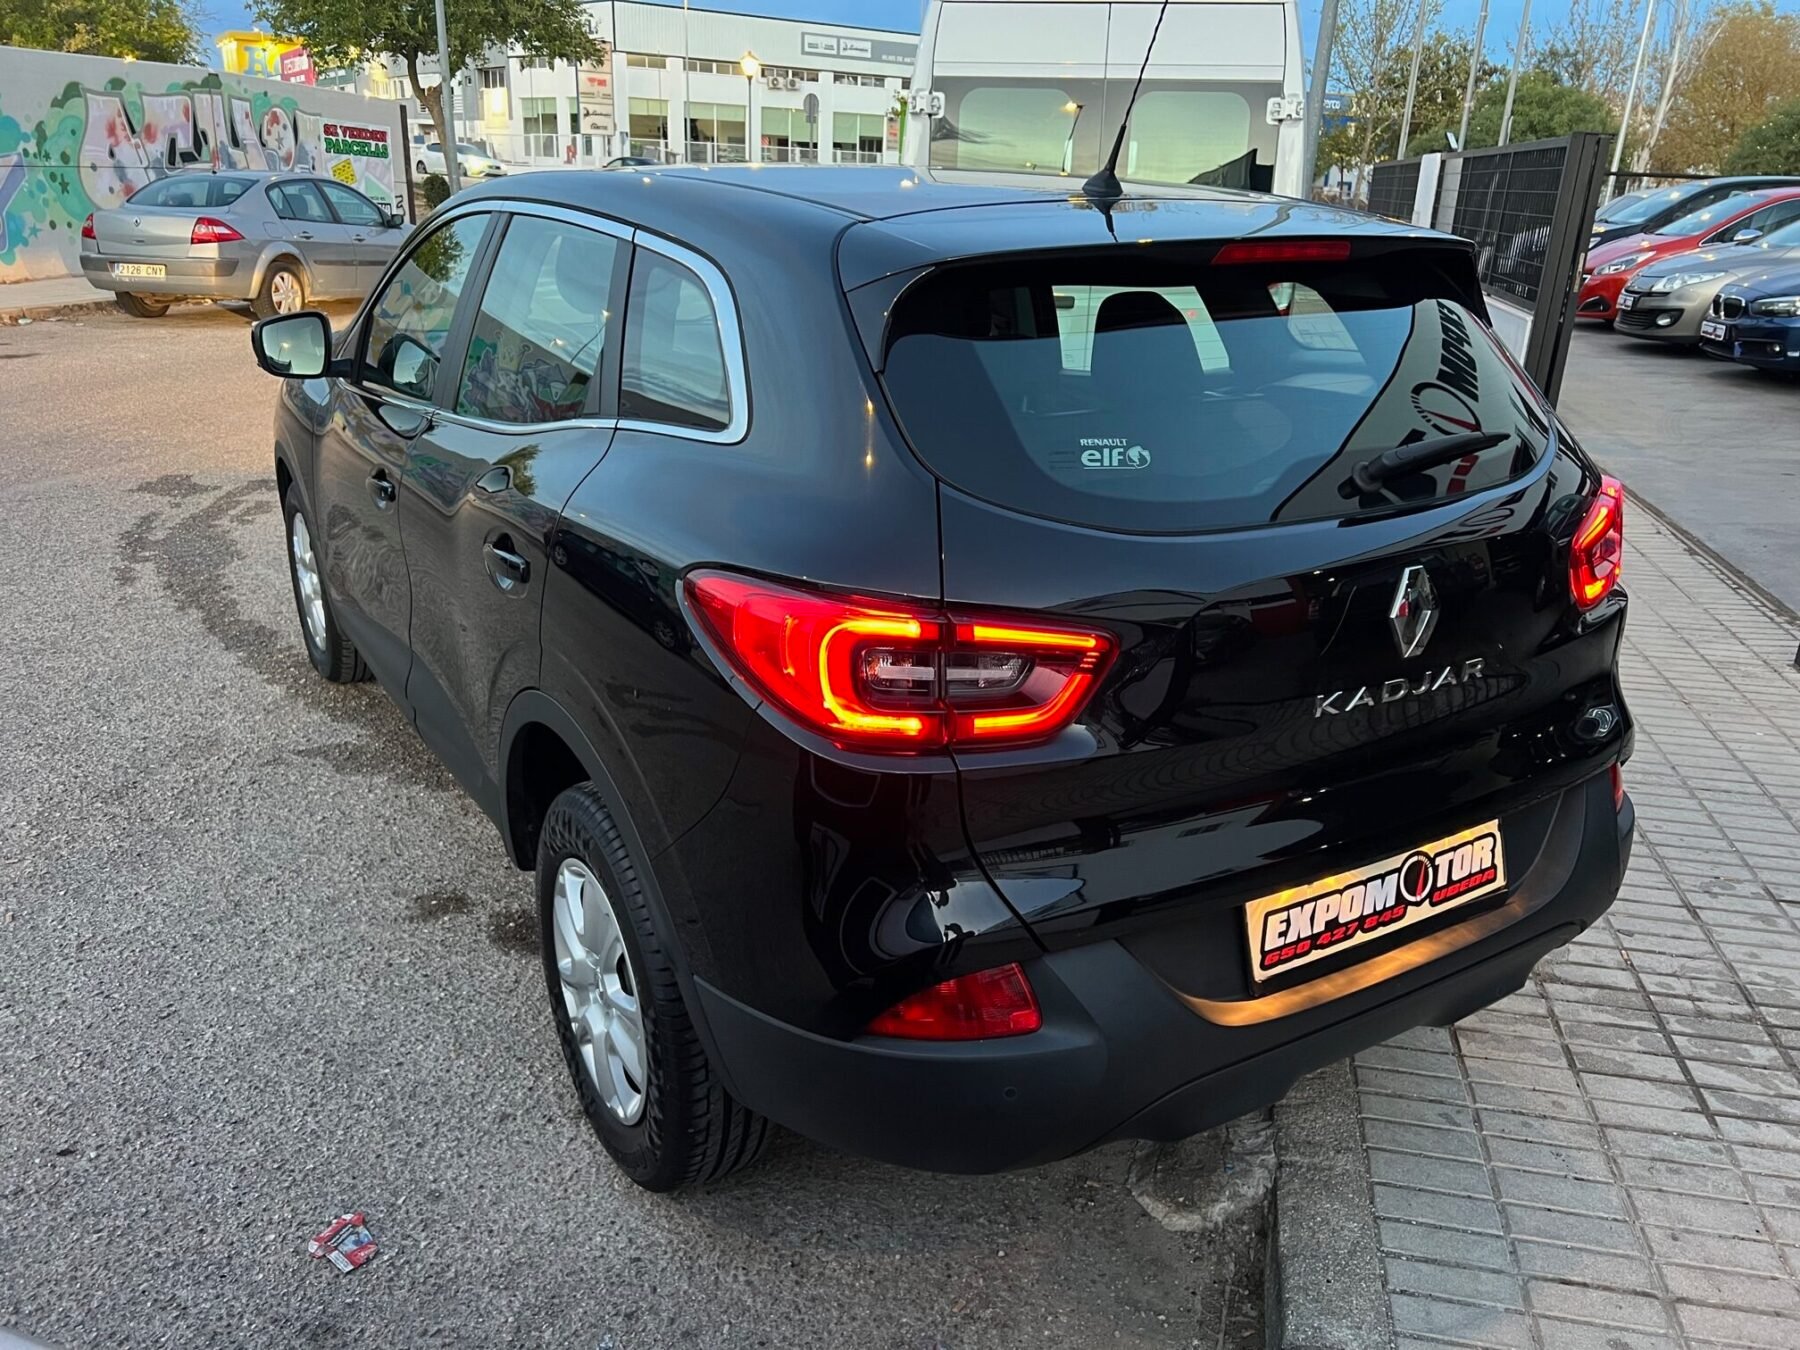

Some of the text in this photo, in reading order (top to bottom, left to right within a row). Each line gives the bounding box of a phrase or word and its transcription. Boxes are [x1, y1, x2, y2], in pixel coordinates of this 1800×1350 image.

[323, 123, 387, 142] SE VENDEN
[324, 137, 389, 158] PARCELAS
[120, 265, 163, 276] 2126 CNY
[1080, 438, 1127, 446] RENAULT
[1081, 448, 1124, 466] elf
[1314, 657, 1485, 718] KADJAR
[1264, 904, 1406, 966] 650 427 845
